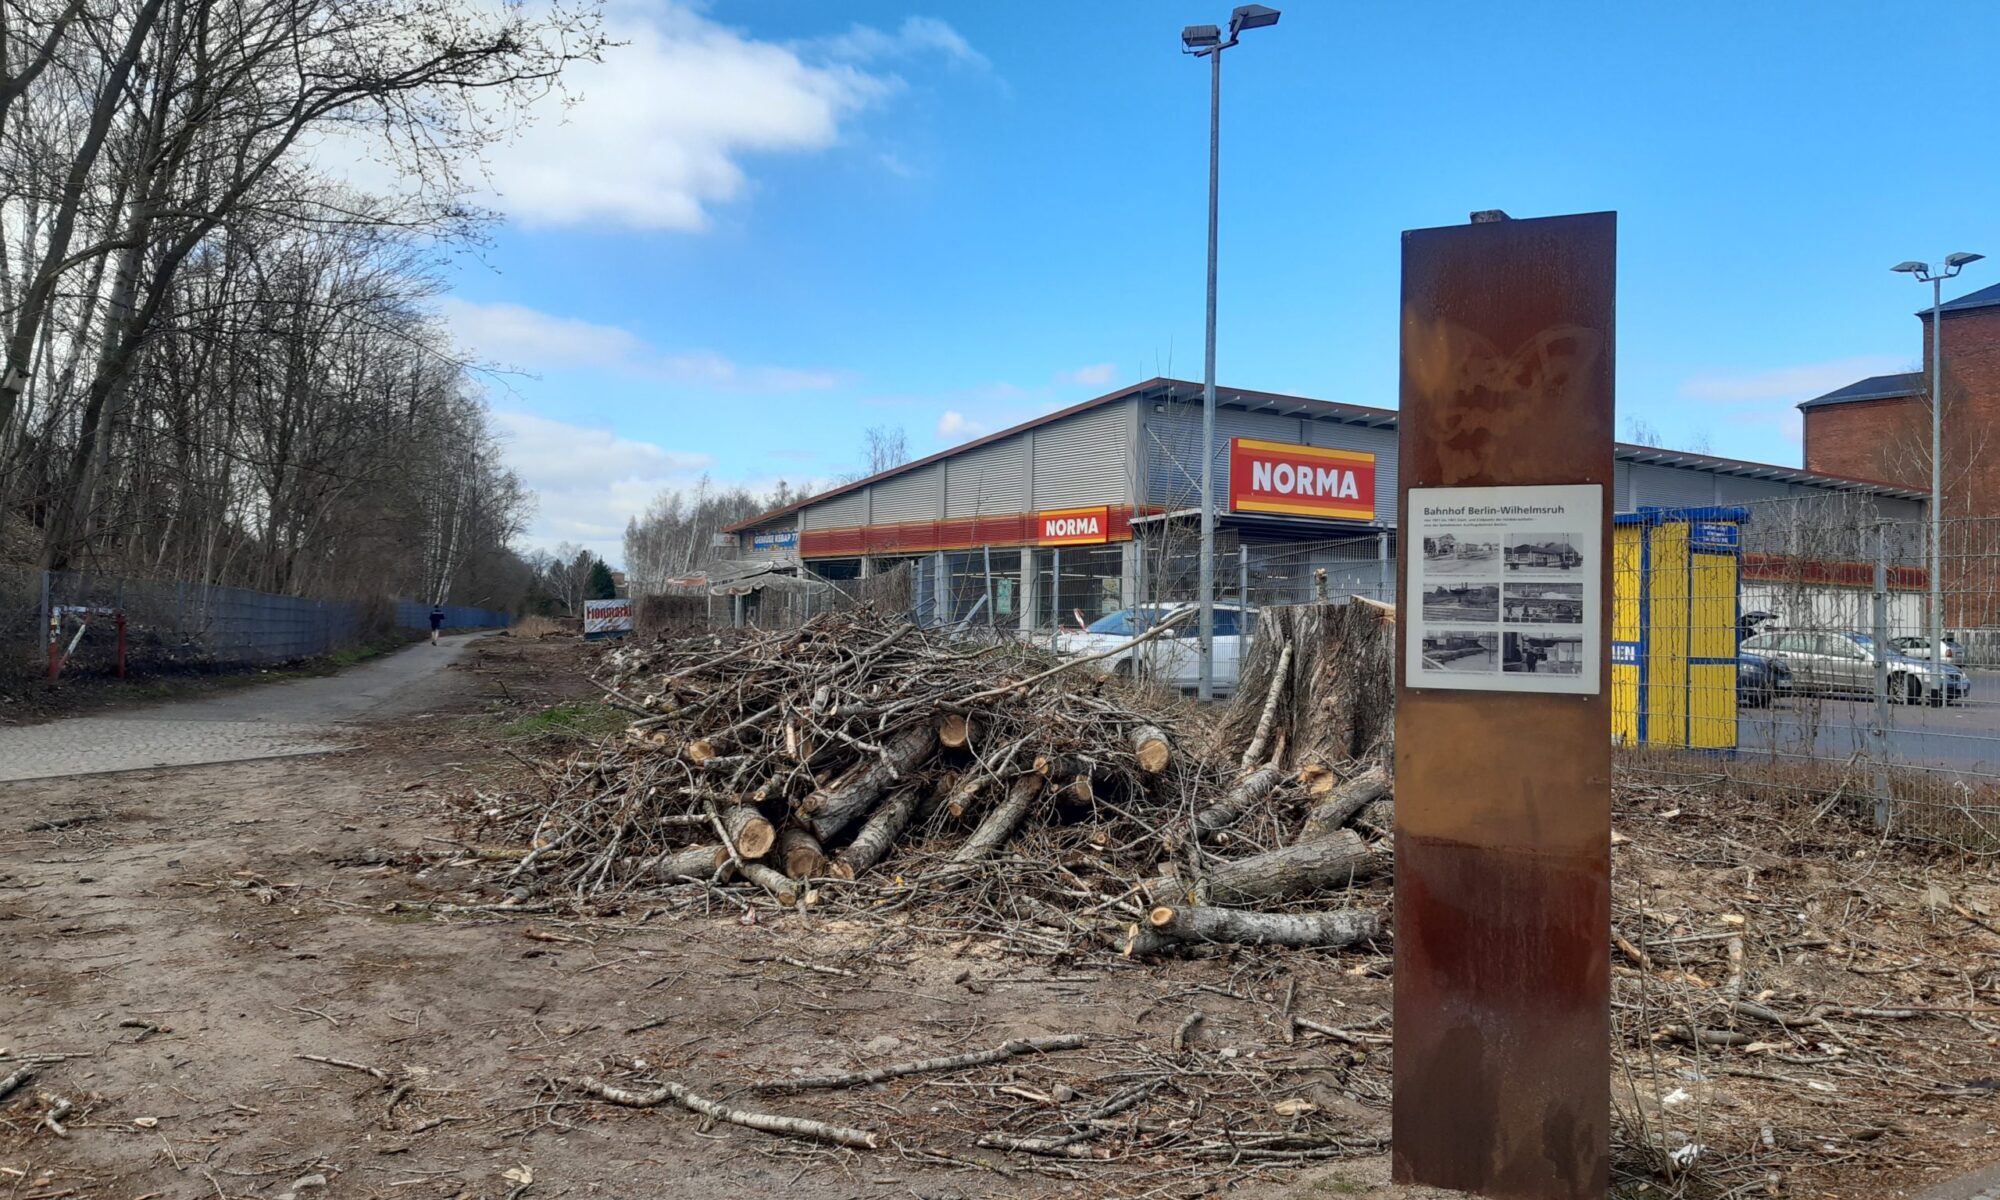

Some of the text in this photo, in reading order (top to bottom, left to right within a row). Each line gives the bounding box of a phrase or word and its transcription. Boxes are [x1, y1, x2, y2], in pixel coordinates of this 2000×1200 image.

[1252, 460, 1359, 500] NORMA
[1423, 505, 1565, 516] Bahnhof Berlin-Wilhelmsruh
[1045, 516, 1099, 536] NORMA
